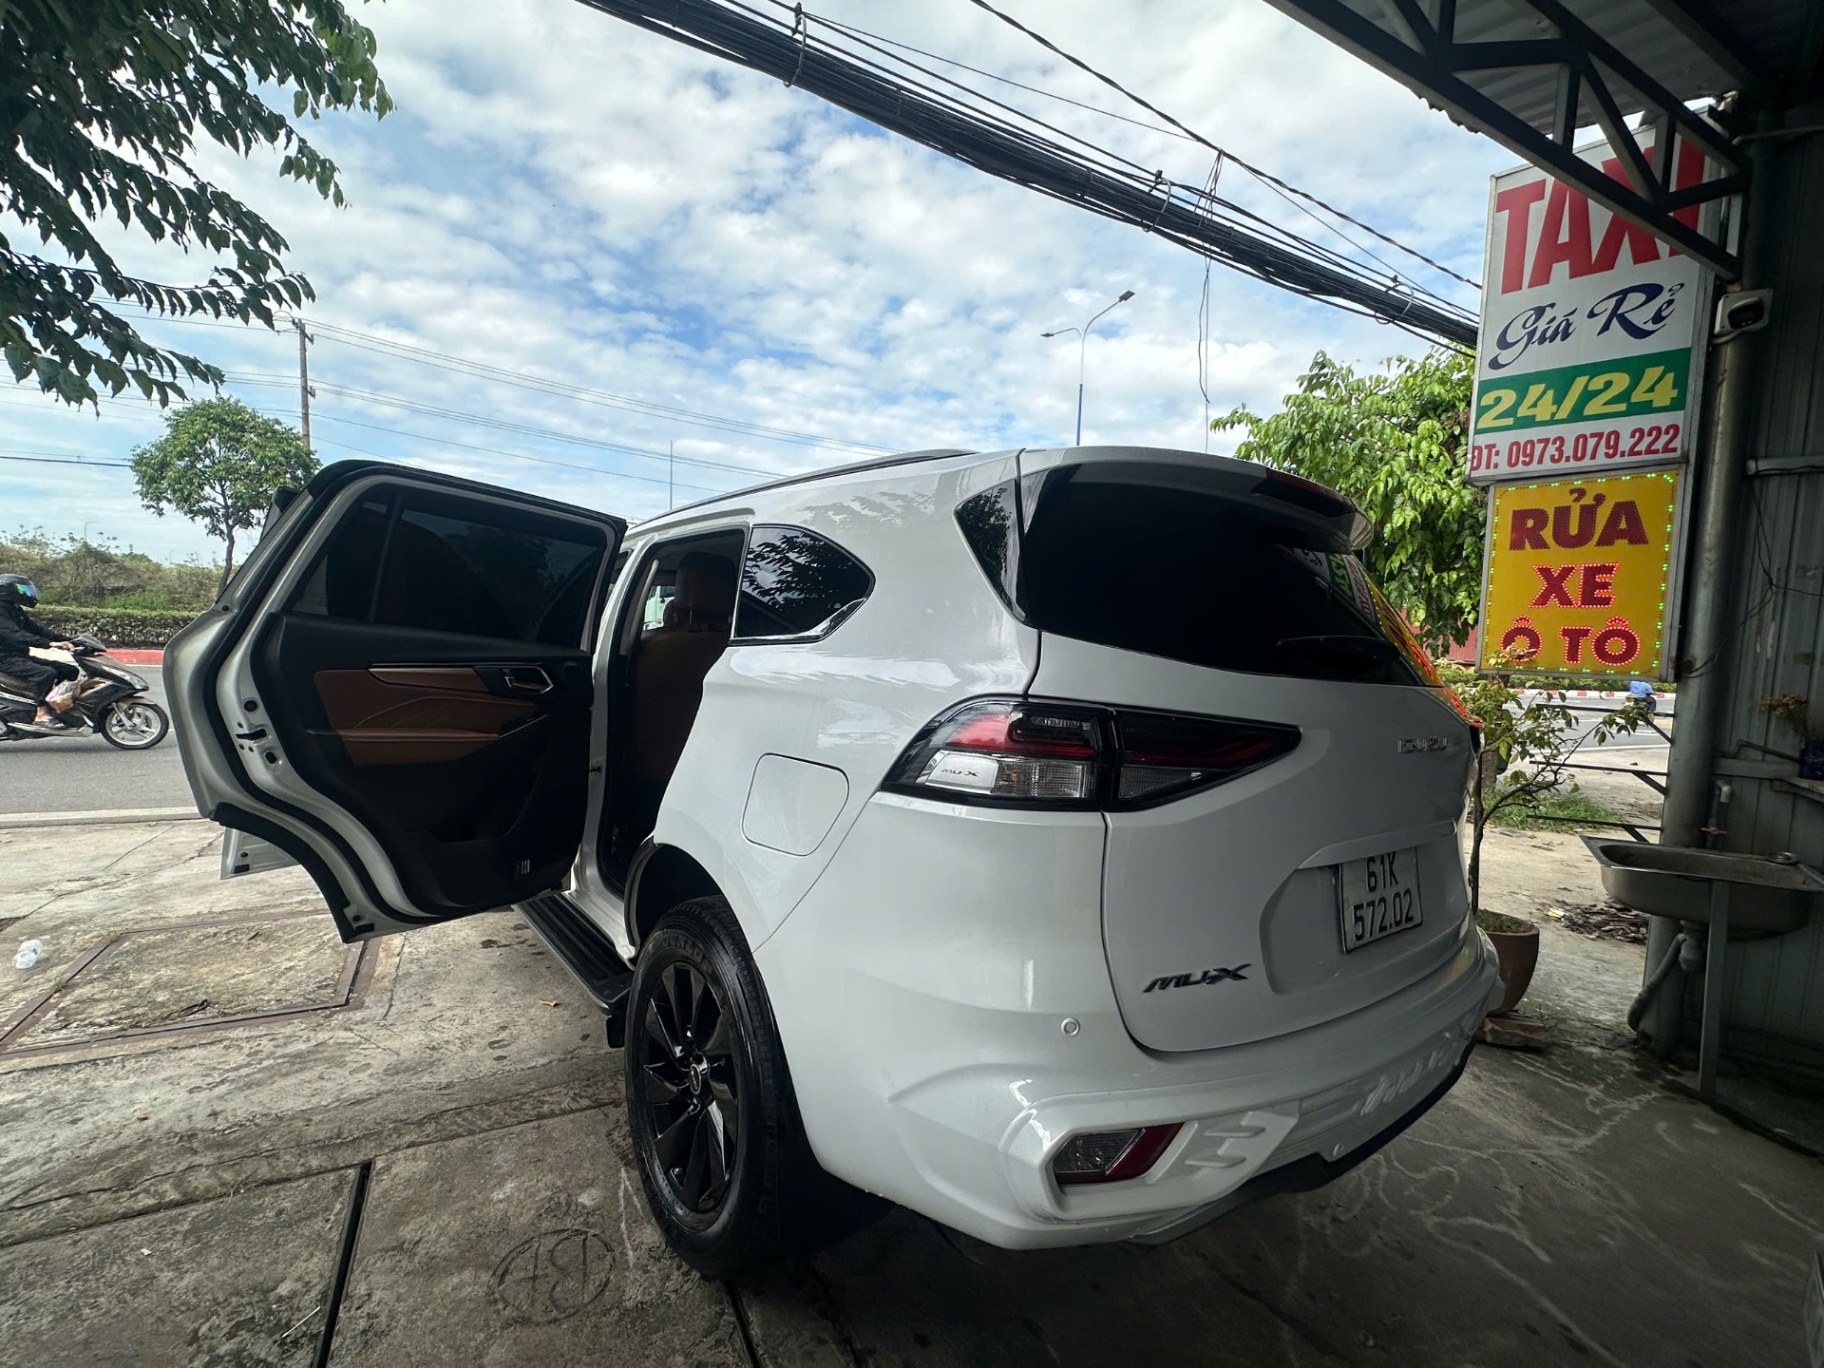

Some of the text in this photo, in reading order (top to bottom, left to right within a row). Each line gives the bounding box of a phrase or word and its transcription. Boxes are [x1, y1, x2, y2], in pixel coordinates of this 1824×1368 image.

[1488, 282, 1685, 370] Giá Rẻ
[1476, 366, 1678, 430] 24/24
[1507, 424, 1680, 468] 0973.079.222
[1509, 487, 1649, 551] RỬA
[1528, 562, 1619, 608] XE
[1500, 615, 1543, 663] Ô
[1559, 615, 1641, 666] TÔ
[1366, 851, 1399, 893] 61K
[1353, 888, 1414, 942] 572.02
